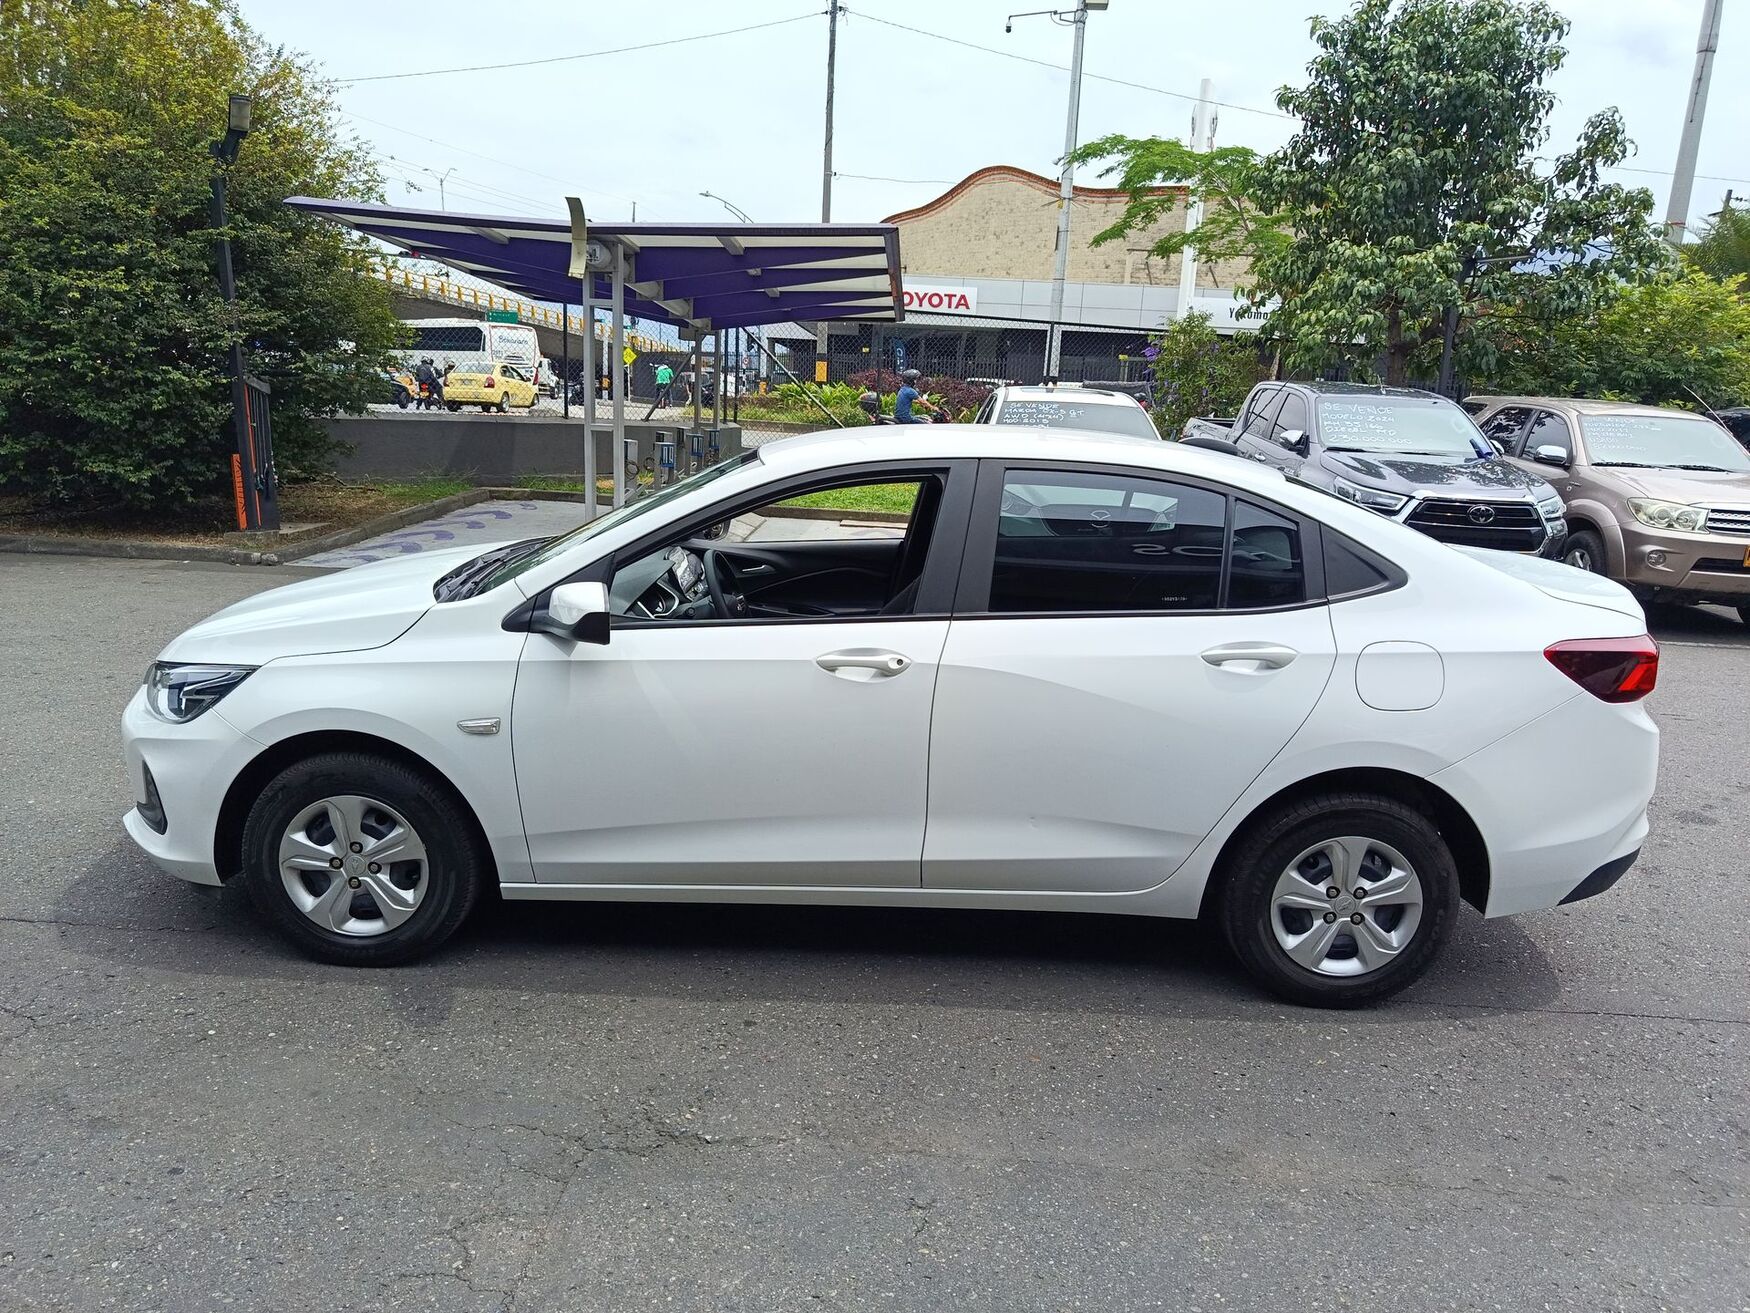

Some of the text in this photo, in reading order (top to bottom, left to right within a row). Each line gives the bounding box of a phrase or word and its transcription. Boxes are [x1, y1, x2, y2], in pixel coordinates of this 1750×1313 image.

[903, 291, 970, 310] OYOTA
[1026, 402, 1060, 410] VENDE
[1324, 402, 1393, 414] SE VENDE
[1322, 412, 1364, 420] MODELO
